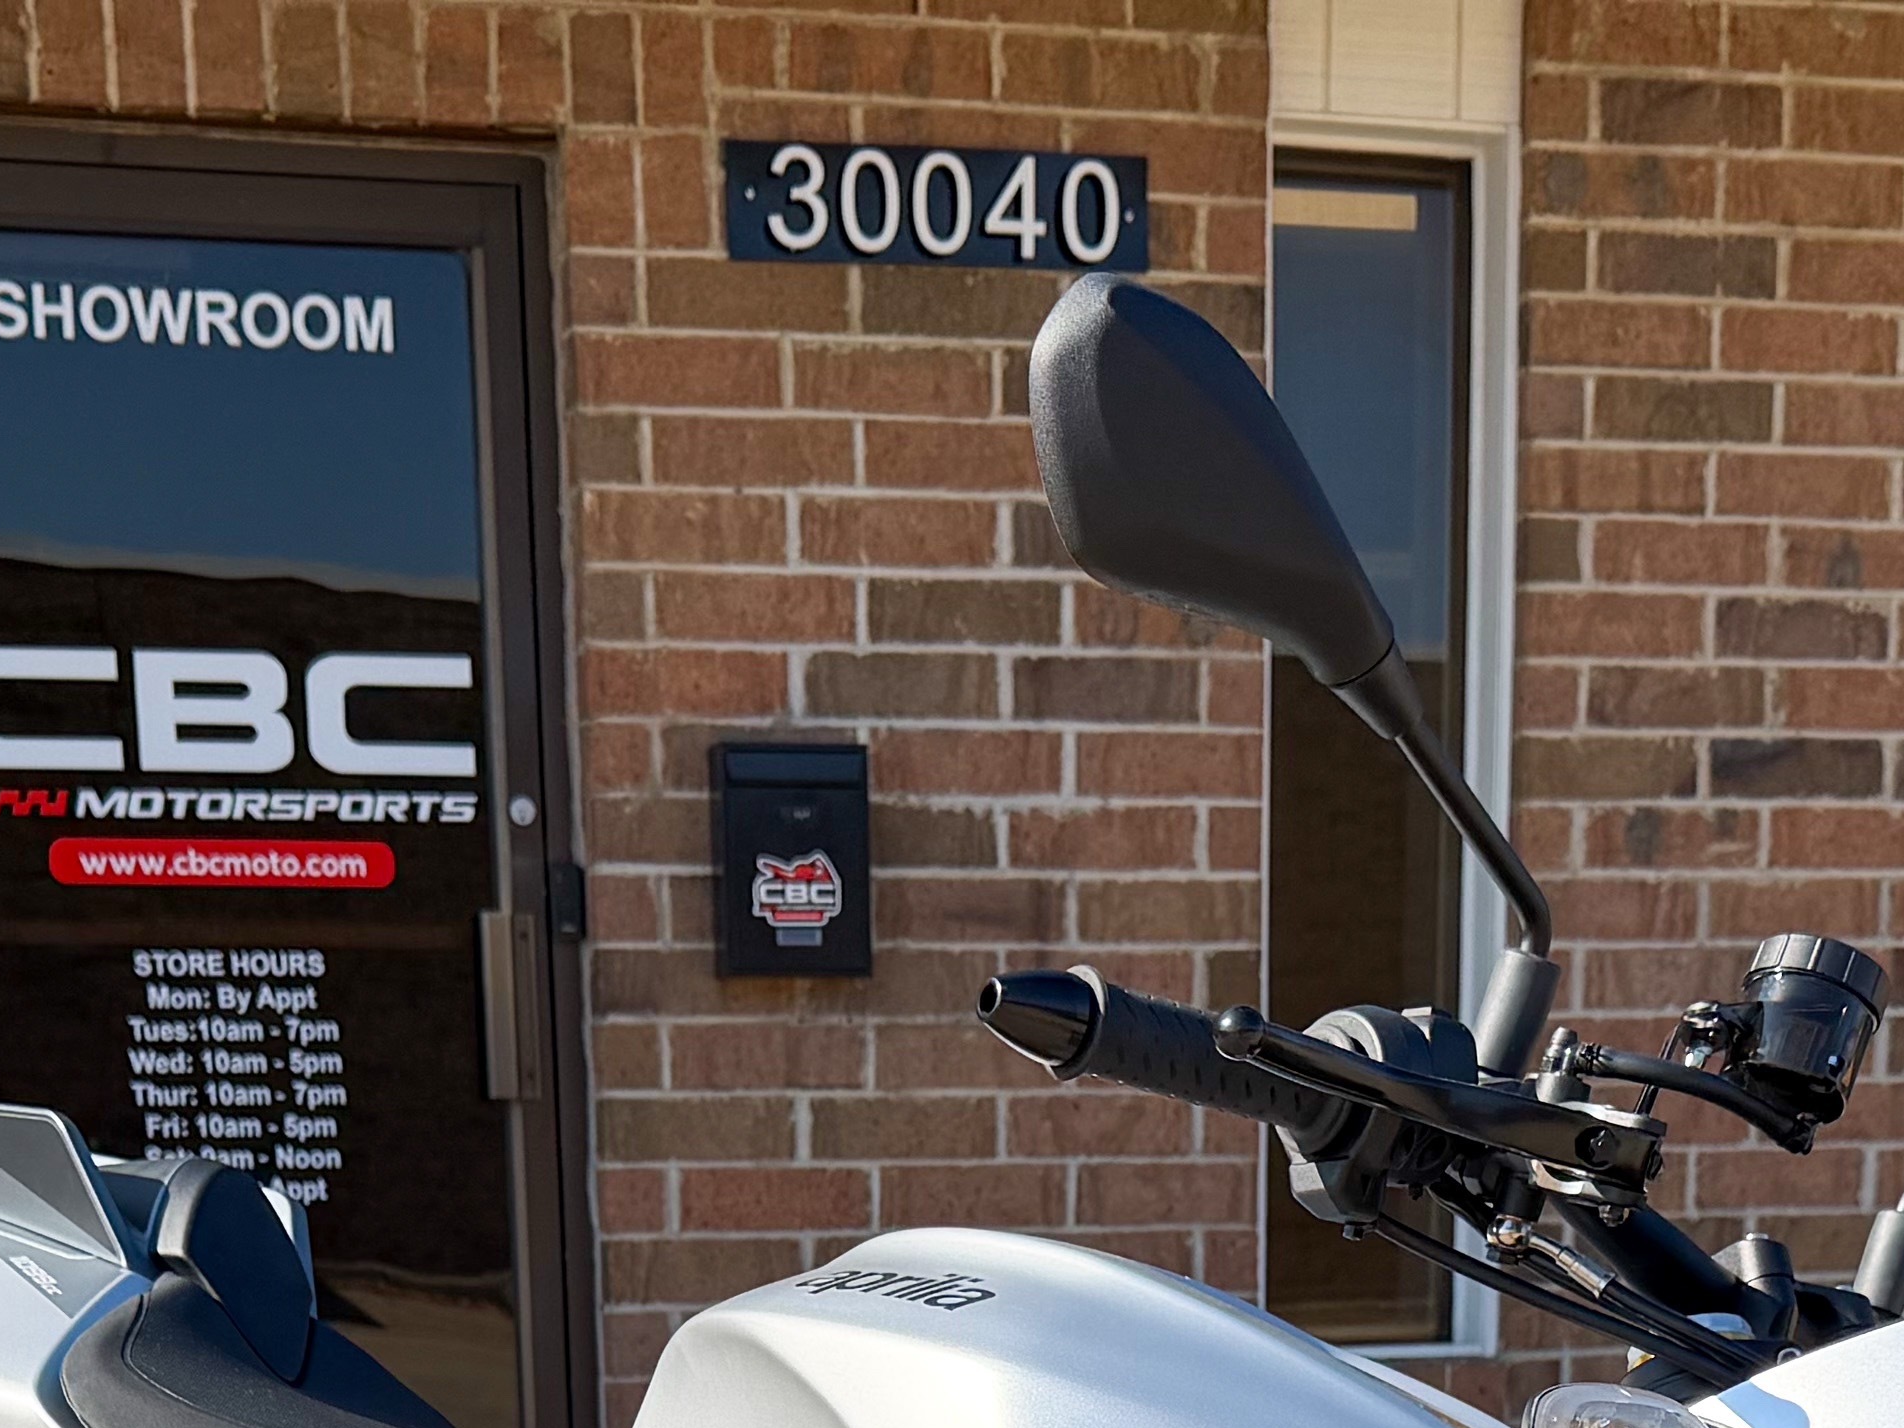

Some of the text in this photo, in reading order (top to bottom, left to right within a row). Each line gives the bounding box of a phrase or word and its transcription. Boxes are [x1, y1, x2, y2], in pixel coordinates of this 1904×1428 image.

[767, 144, 1120, 264] 30040
[74, 788, 478, 823] MOTORSPORTS
[78, 846, 368, 879] www.cbcmoto.com
[758, 880, 836, 905] CBC
[133, 949, 326, 978] STORE HOURS
[146, 982, 318, 1014] Mon: By Appt
[284, 1016, 340, 1047] 7pm
[127, 1047, 194, 1074] Wed:
[201, 1047, 268, 1074] 10am
[288, 1049, 343, 1079] 5pm
[129, 1079, 198, 1107] Thur:
[204, 1079, 272, 1106] 10am
[291, 1080, 347, 1111] 7pm
[145, 1112, 190, 1139] Fri:
[195, 1112, 263, 1139] 10am
[283, 1112, 338, 1143] 5pm
[274, 1143, 343, 1170] Noon
[794, 1270, 996, 1311] aprilia
